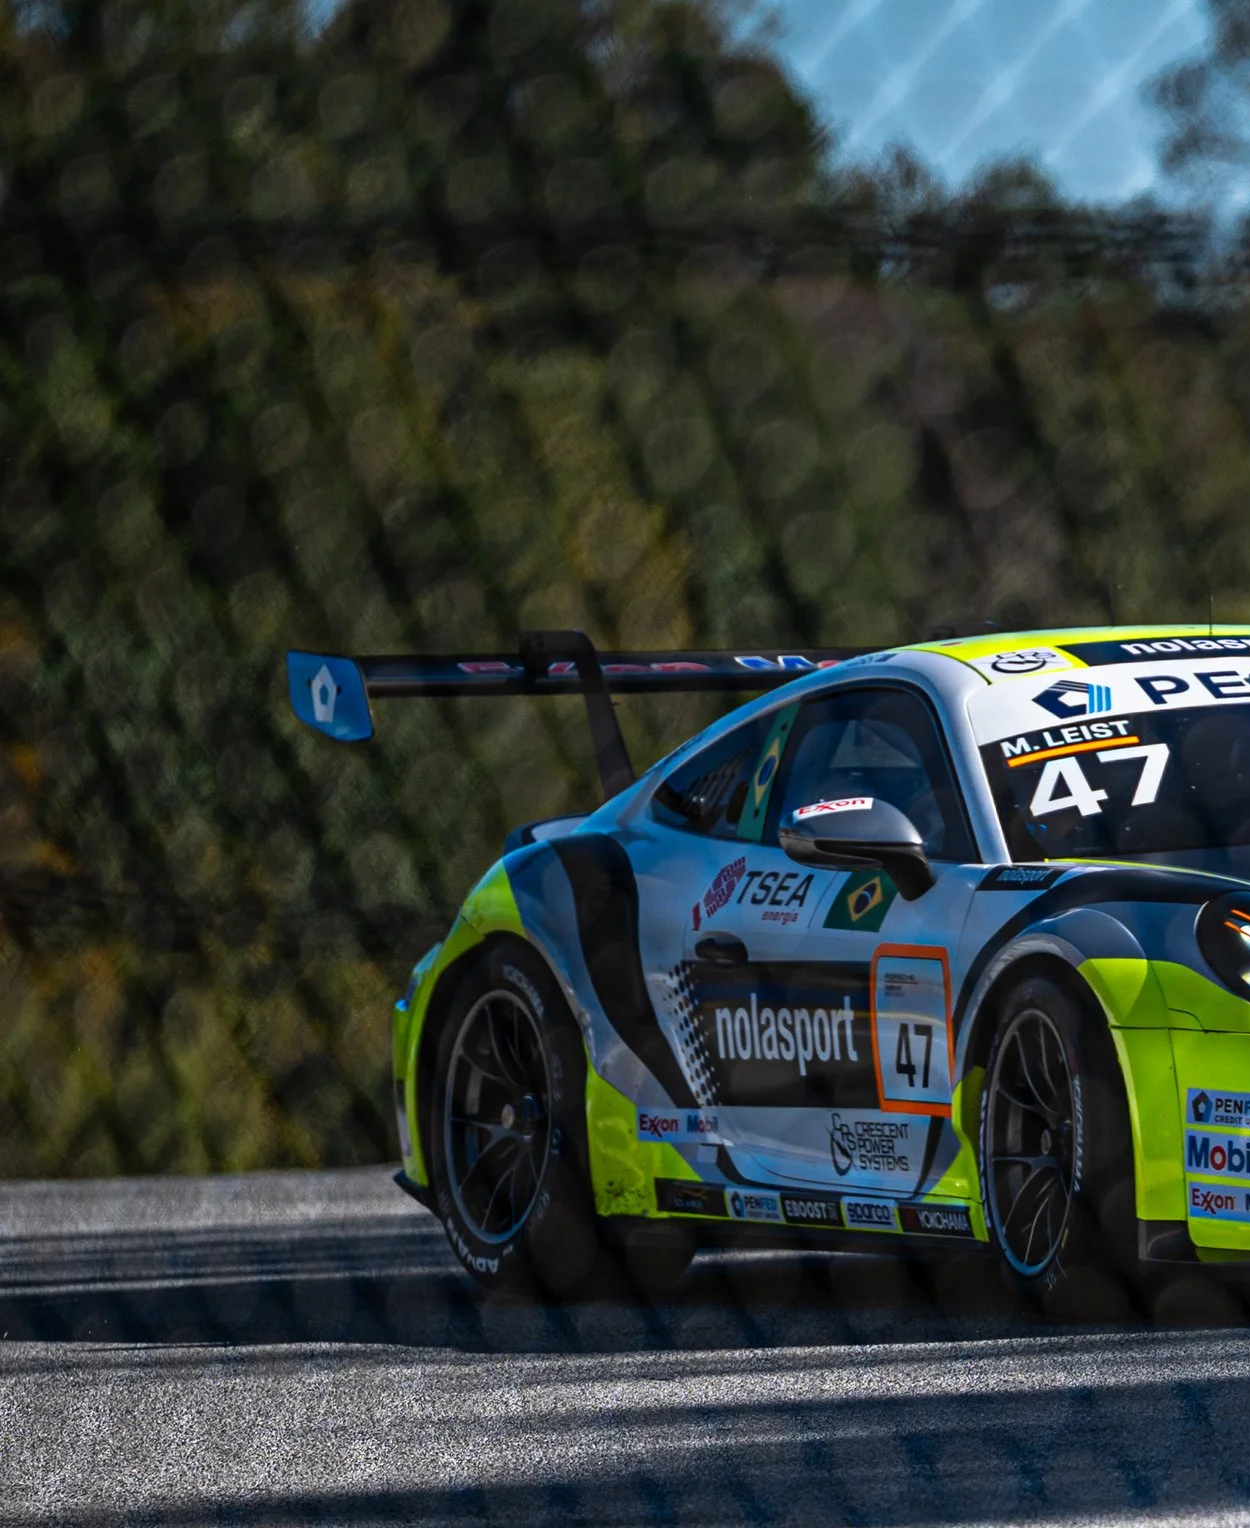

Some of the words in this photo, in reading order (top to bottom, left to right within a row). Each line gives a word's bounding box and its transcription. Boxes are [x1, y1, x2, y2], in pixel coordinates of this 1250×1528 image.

[1000, 737, 1040, 758] M.
[1043, 719, 1130, 747] LEIST
[1029, 743, 1170, 817] 47
[797, 798, 866, 816] Exxon
[736, 870, 816, 908] TSEA
[715, 992, 859, 1077] nolasport
[895, 1022, 933, 1089] 47
[639, 1113, 679, 1138] Exxon
[686, 1115, 719, 1133] Mobil
[854, 1121, 909, 1139] CRESCENT
[1214, 1115, 1242, 1125] CREDIT
[857, 1138, 895, 1155] POWER
[859, 1154, 910, 1172] SYSTEMS
[744, 1195, 778, 1211] PENFED
[784, 1199, 827, 1219] EBOOST
[847, 1201, 890, 1221] sparco
[1191, 1187, 1236, 1215] Exxon
[917, 1209, 970, 1231] YOKOHAMA
